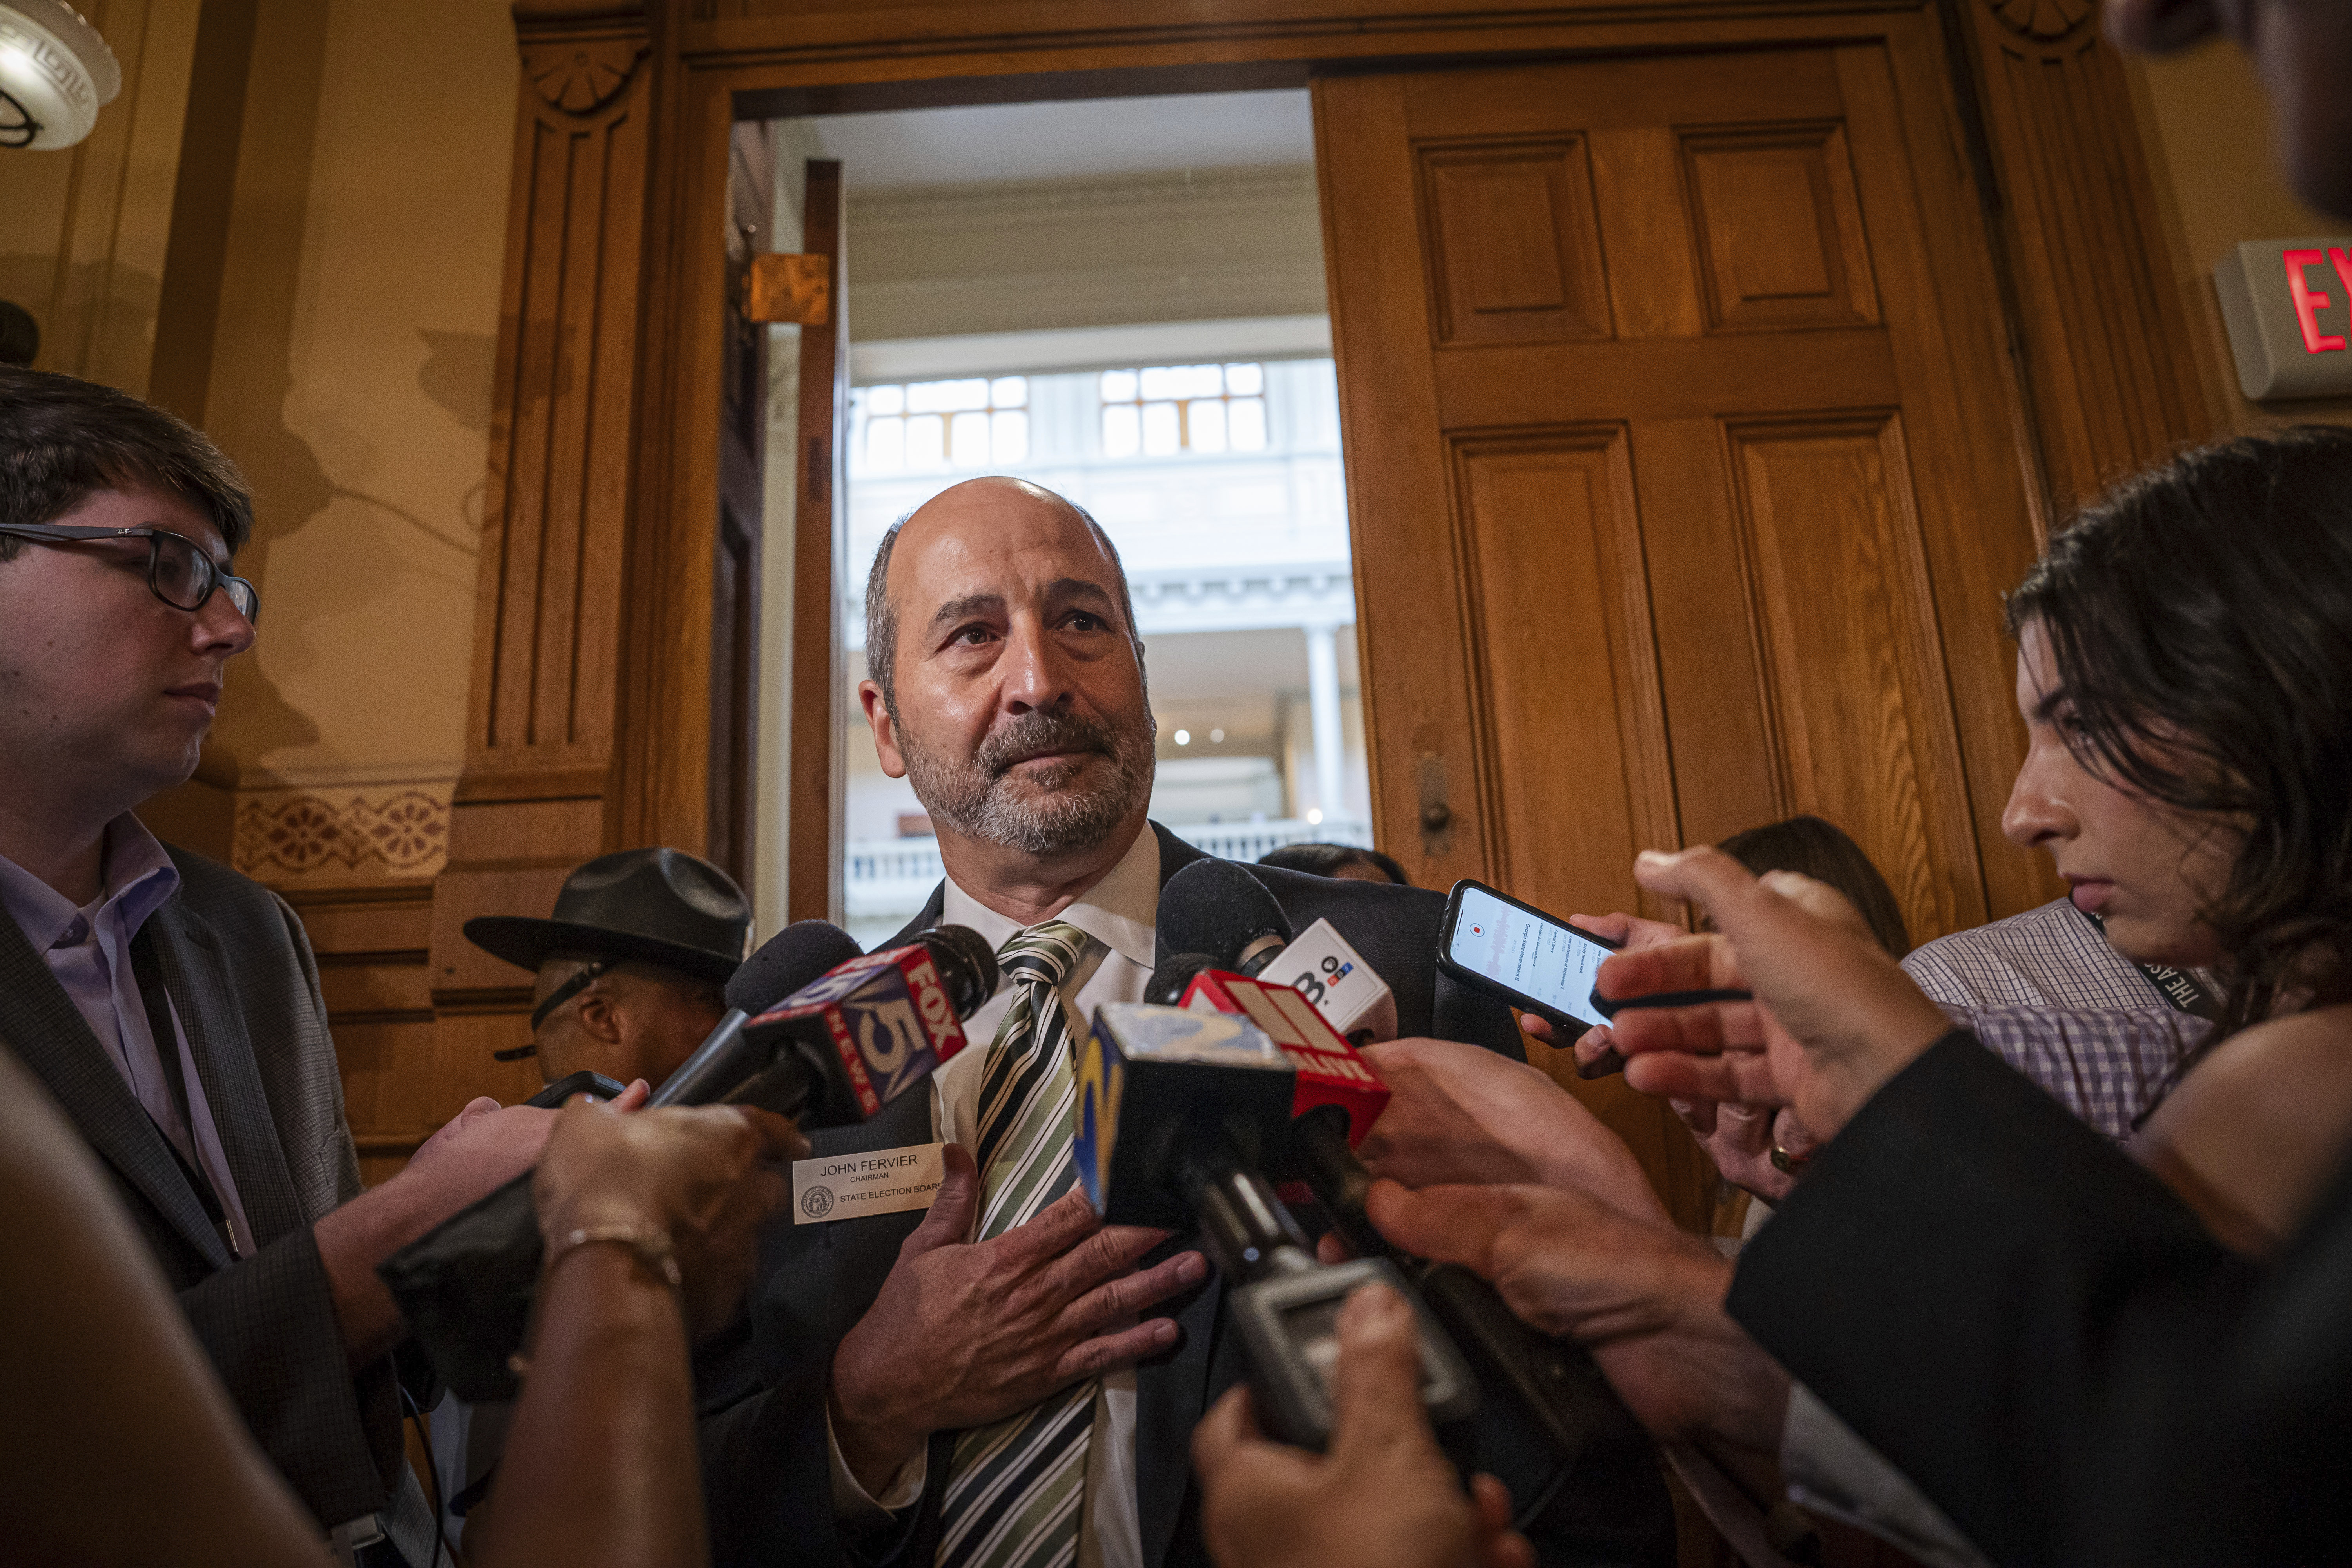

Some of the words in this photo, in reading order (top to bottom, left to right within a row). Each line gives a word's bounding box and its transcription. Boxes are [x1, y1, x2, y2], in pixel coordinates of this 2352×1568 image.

[1516, 951, 1525, 977] Government
[2144, 963, 2178, 980] AS
[2164, 976, 2200, 1008] THE
[907, 960, 960, 1054] FOX
[858, 998, 927, 1073] 5
[821, 1162, 856, 1176] JOHN
[861, 1154, 918, 1171] FERVIER
[850, 1172, 889, 1183] CHAIRMAN
[840, 1192, 867, 1203] STATE
[869, 1186, 911, 1199] ELECTION
[914, 1182, 940, 1193] BOAR
